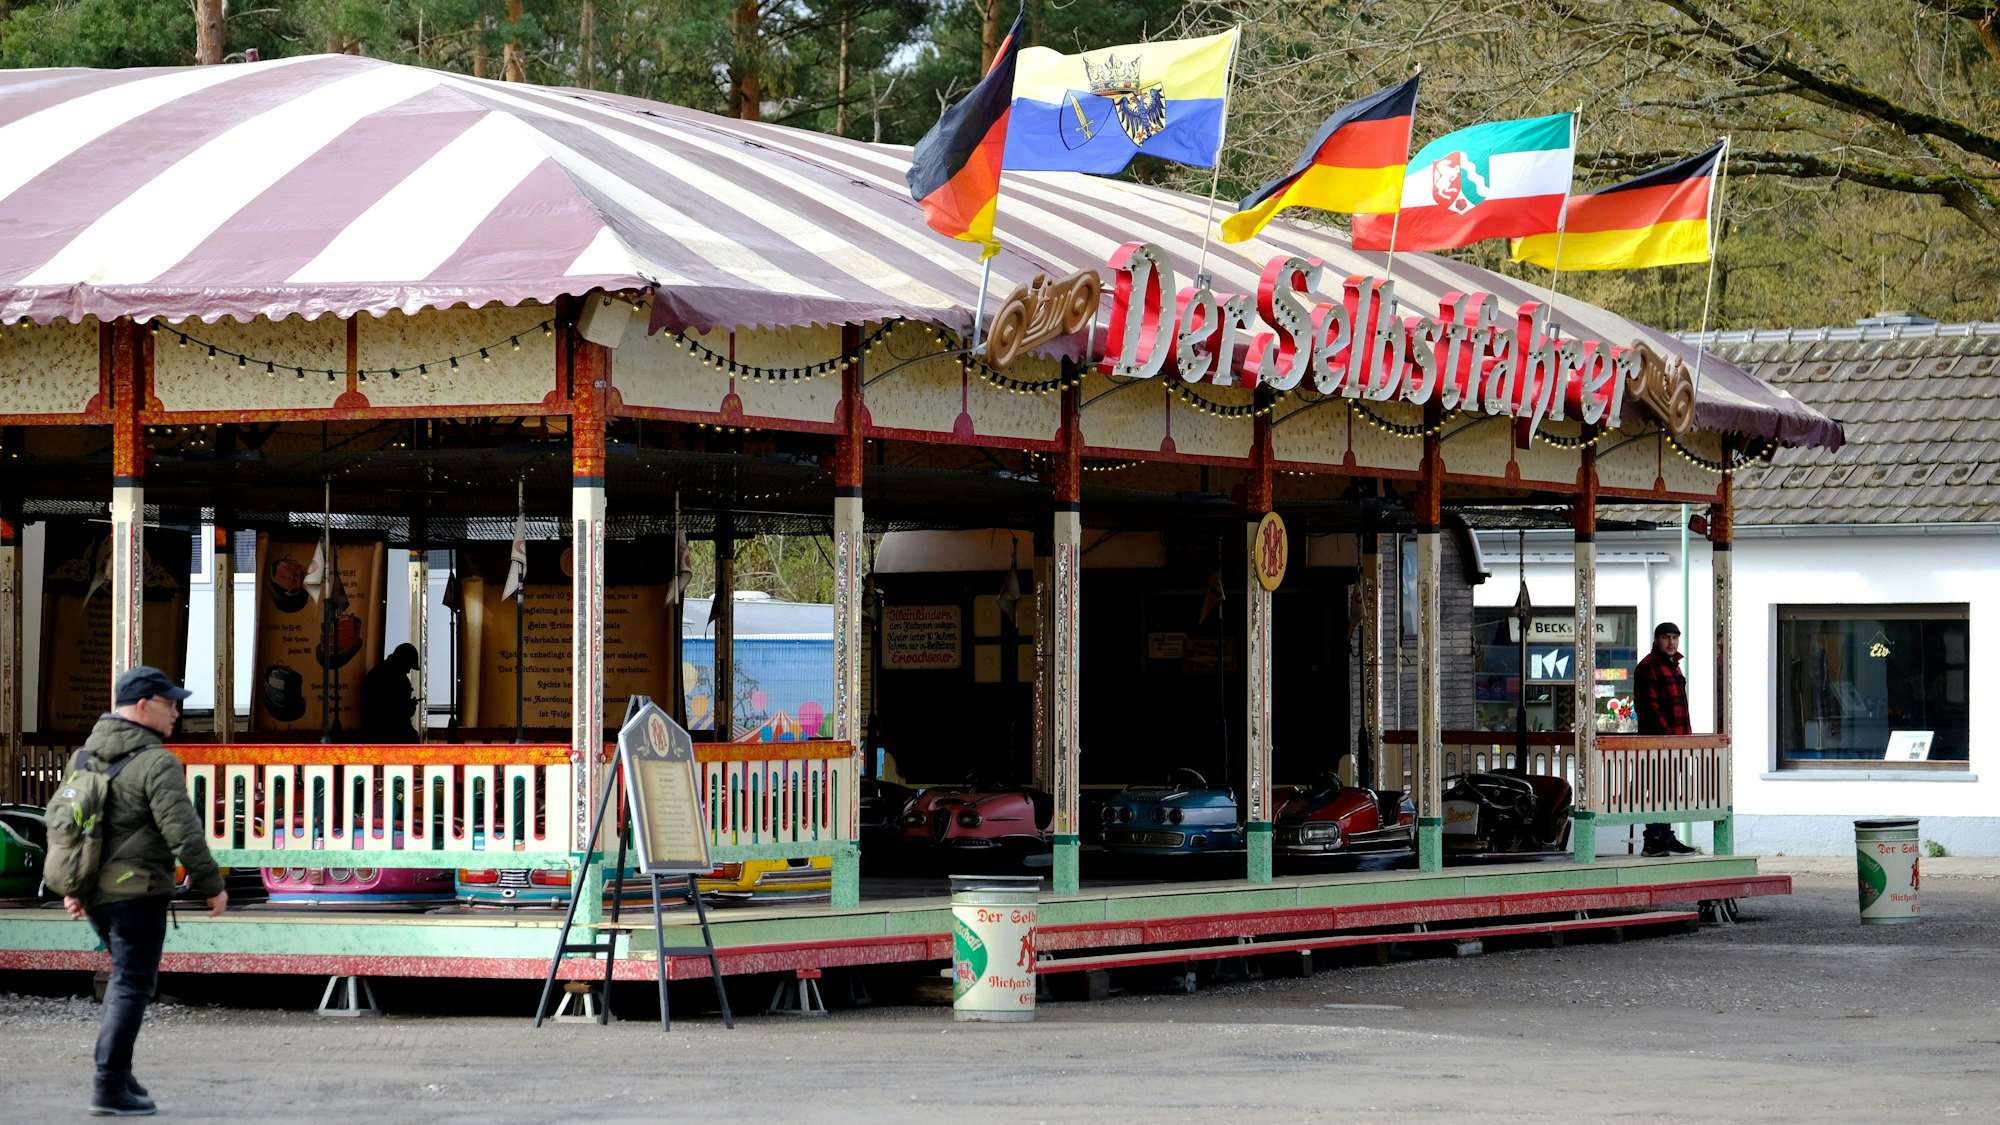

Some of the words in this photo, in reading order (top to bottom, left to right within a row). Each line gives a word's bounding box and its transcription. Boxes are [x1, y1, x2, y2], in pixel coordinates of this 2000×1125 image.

[1097, 241, 1256, 386] Der
[1241, 255, 1642, 450] Selbstfahrer
[888, 608, 953, 621] Kleinkindern
[528, 621, 547, 631] Beim
[524, 636, 560, 644] Fahrbahn
[530, 651, 564, 660] unbedingt
[891, 651, 956, 663] Erwachsener.
[498, 665, 513, 673] Das
[538, 680, 561, 690] Rechts
[551, 710, 571, 719] Folge
[1877, 843, 1896, 855] Der
[24, 851, 34, 868] 8
[977, 908, 1003, 924] Der
[988, 975, 1031, 993] Richard
